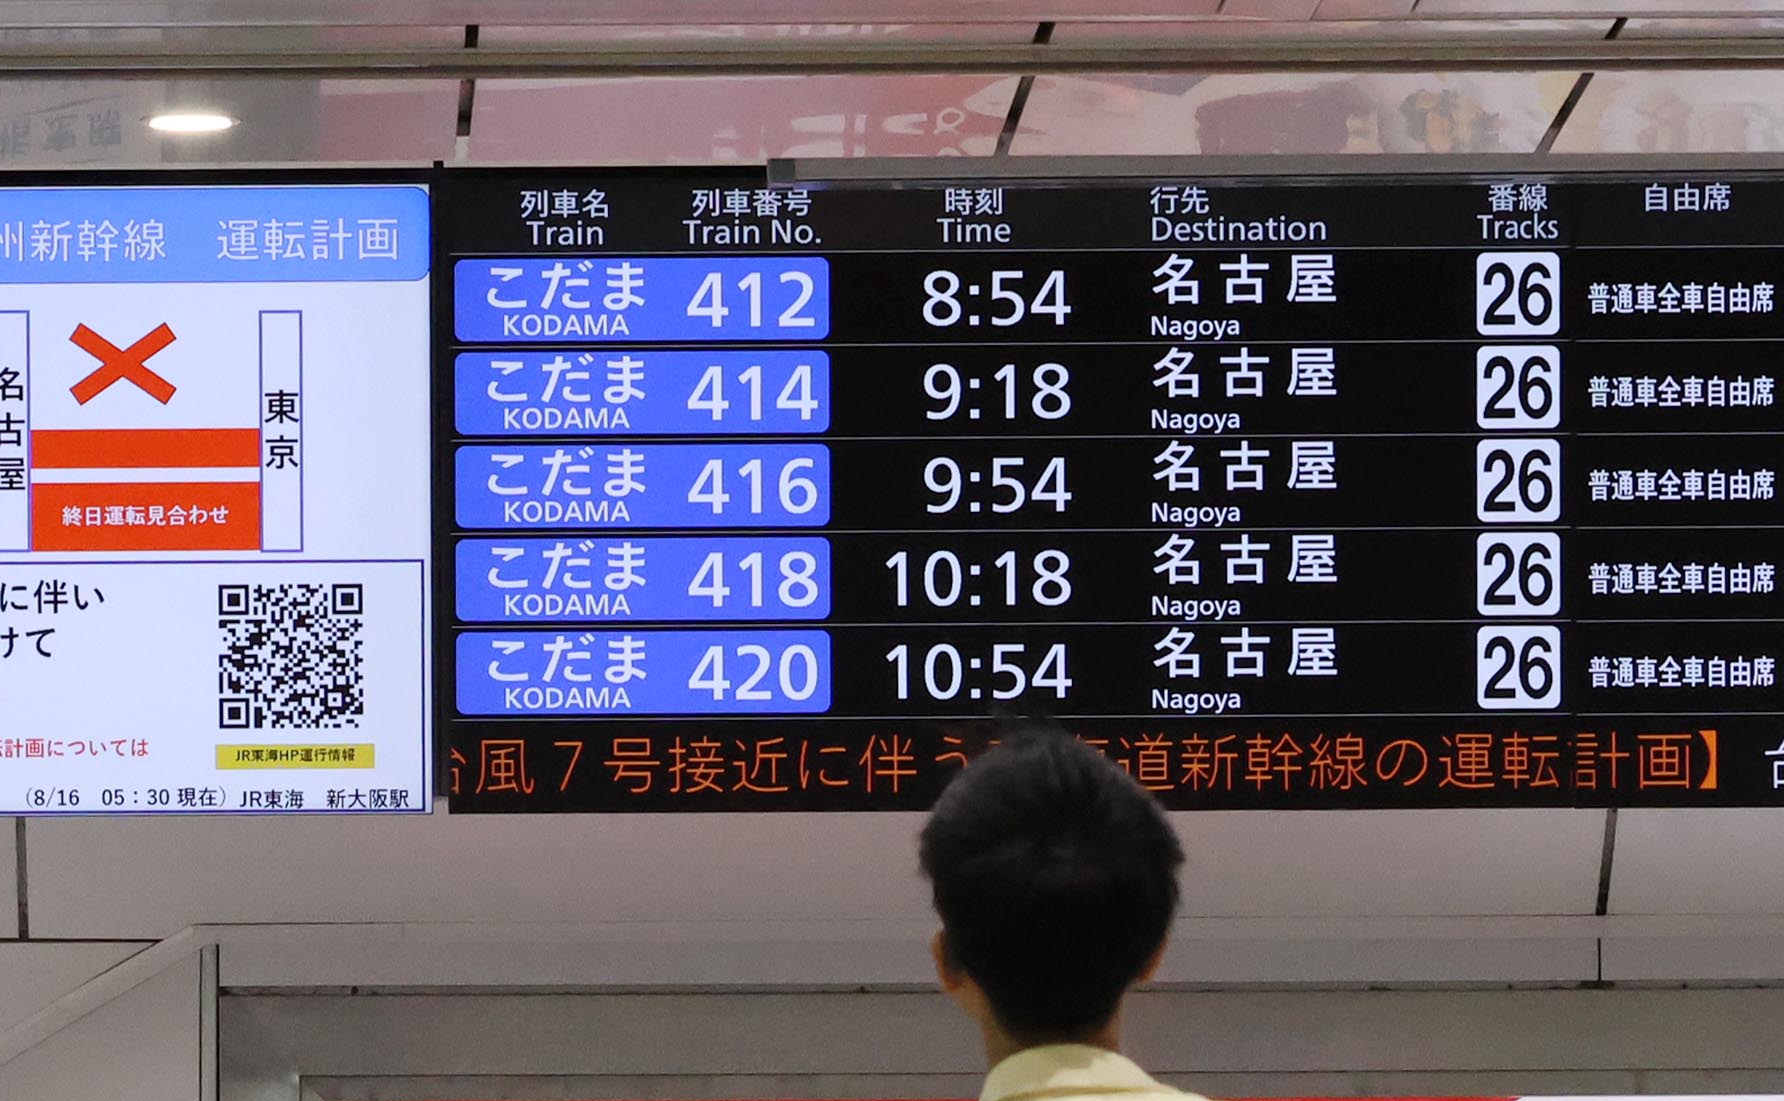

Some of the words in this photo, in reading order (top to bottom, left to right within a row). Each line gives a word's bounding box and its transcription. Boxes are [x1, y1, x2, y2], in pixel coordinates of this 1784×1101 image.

[519, 188, 611, 219] 列車名
[691, 187, 812, 219] 列車番号
[943, 186, 1004, 217] 時刻
[1149, 184, 1210, 216] 行先
[1486, 182, 1549, 213] 番線
[1642, 181, 1732, 213] 自由席
[215, 216, 400, 262] 運転計画
[525, 220, 605, 248] Train
[682, 219, 763, 247] Train
[770, 219, 822, 247] No.
[935, 217, 1012, 245] Time
[1150, 215, 1327, 243] Destination
[1476, 213, 1560, 242] Tracks
[485, 261, 646, 310] こだま
[686, 270, 820, 329] 412
[921, 268, 1073, 328] 8:54
[1150, 252, 1338, 305] 名古屋
[1480, 260, 1556, 328] 26
[1586, 281, 1776, 316] 普通車全車自由席
[502, 315, 631, 337] KODAMA
[1149, 315, 1242, 341] Nagoya
[485, 354, 646, 404] こだま
[686, 363, 820, 422] 414
[921, 361, 1073, 422] 9:18
[1150, 346, 1338, 398] 名古屋
[1480, 353, 1556, 421] 26
[1586, 374, 1776, 409] 普通車全車自由席
[263, 389, 300, 470] 東京
[502, 408, 631, 431] KODAMA
[1149, 408, 1242, 434] Nagoya
[485, 448, 646, 497] こだま
[686, 457, 820, 516] 416
[921, 454, 1073, 515] 9:54
[1150, 439, 1338, 491] 名古屋
[1480, 447, 1556, 514] 26
[1586, 468, 1776, 502] 普通車全車自由席
[61, 505, 229, 528] 終日運転見合わせ
[502, 501, 631, 524] KODAMA
[1149, 501, 1242, 528] Nagoya
[485, 541, 646, 590] こだま
[686, 550, 820, 609] 418
[885, 548, 1073, 608] 10:18
[1150, 532, 1338, 585] 名古屋
[1480, 540, 1556, 608] 26
[1586, 561, 1776, 596] 普通車全車自由席
[502, 595, 631, 618] KODAMA
[1149, 595, 1242, 621] Nagoya
[485, 635, 646, 684] こだま
[686, 643, 820, 702] 420
[885, 641, 1073, 702] 10:54
[1150, 626, 1338, 678] 名古屋
[1480, 634, 1556, 701] 26
[1586, 654, 1776, 689] 普通車全車自由席
[502, 688, 631, 711] KODAMA
[1149, 688, 1242, 714] Nagoya
[234, 746, 356, 764] JR東海HP運行情報
[239, 788, 306, 811] JR東海
[325, 787, 411, 811] 新大阪駅
